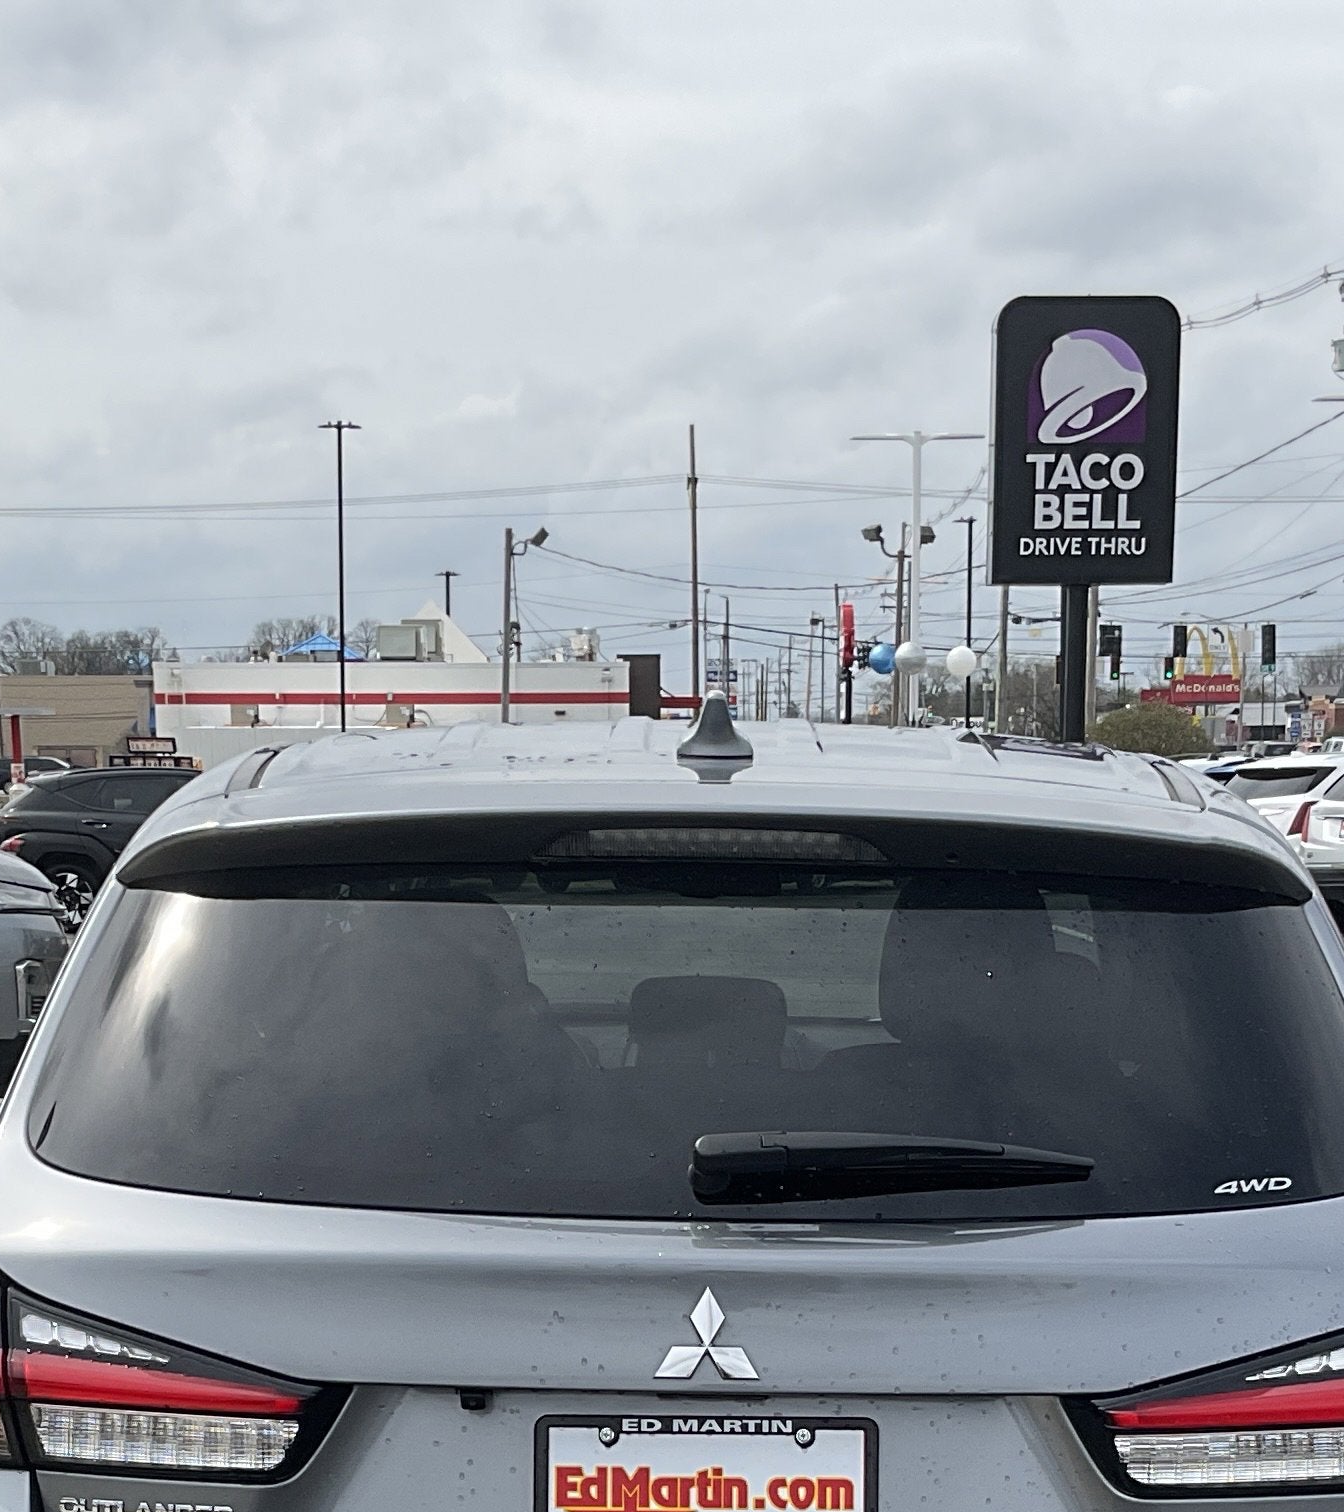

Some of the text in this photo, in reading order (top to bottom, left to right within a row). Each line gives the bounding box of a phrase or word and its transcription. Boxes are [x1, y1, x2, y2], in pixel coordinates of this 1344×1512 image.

[1025, 453, 1145, 490] TACO
[1034, 493, 1141, 530] BELL
[1019, 537, 1146, 556] DRIVE THRU
[1214, 1177, 1292, 1194] 4WD
[622, 1418, 793, 1433] ED MARTIN
